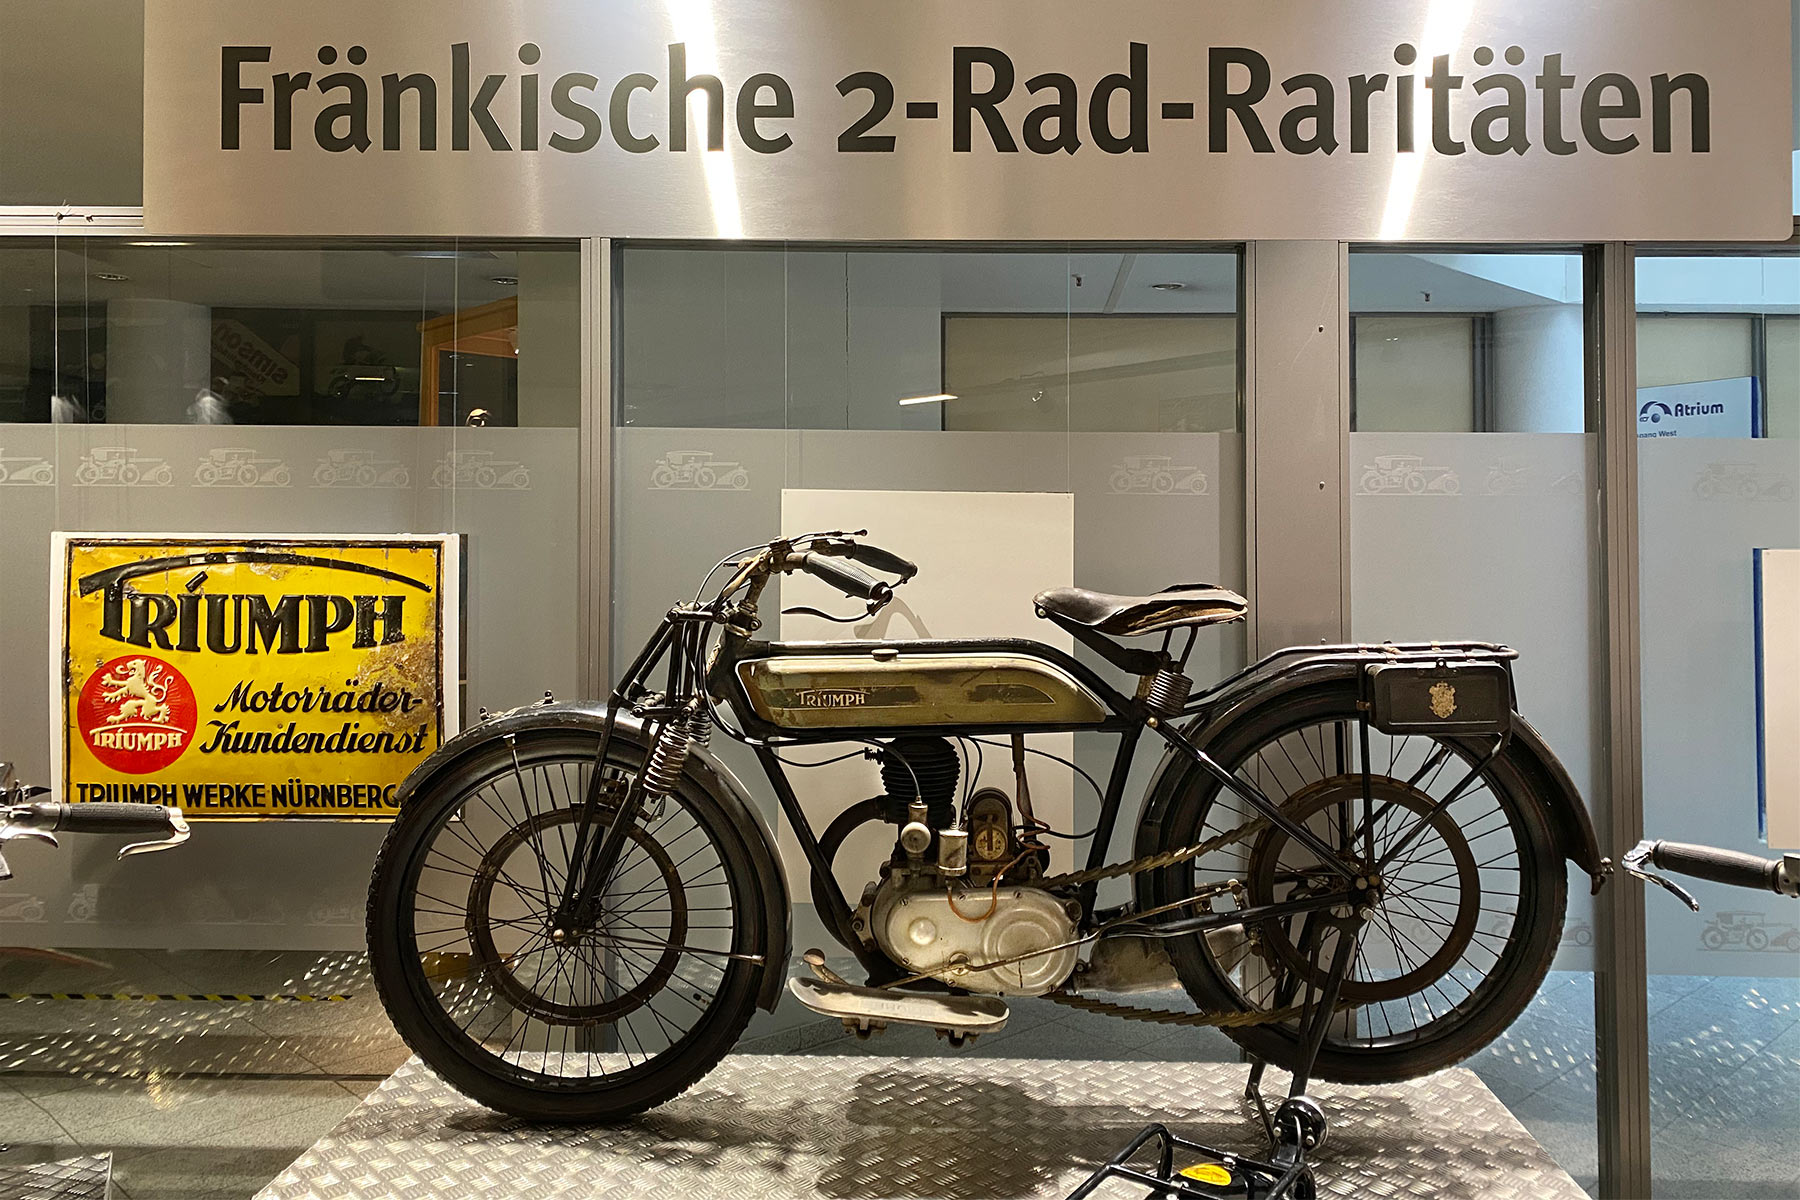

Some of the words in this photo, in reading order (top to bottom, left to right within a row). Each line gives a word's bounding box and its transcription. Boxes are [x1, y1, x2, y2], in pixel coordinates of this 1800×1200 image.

[221, 42, 795, 154] Fränkische
[835, 41, 1711, 157] 2-Rad-Raritäten
[1674, 402, 1724, 417] Atrium
[213, 680, 423, 713] Motorräder-
[199, 719, 428, 754] Kundendienst
[76, 783, 177, 807] TRIUMPH
[182, 784, 266, 808] WERKE
[271, 778, 400, 809] NÜRNBERG
